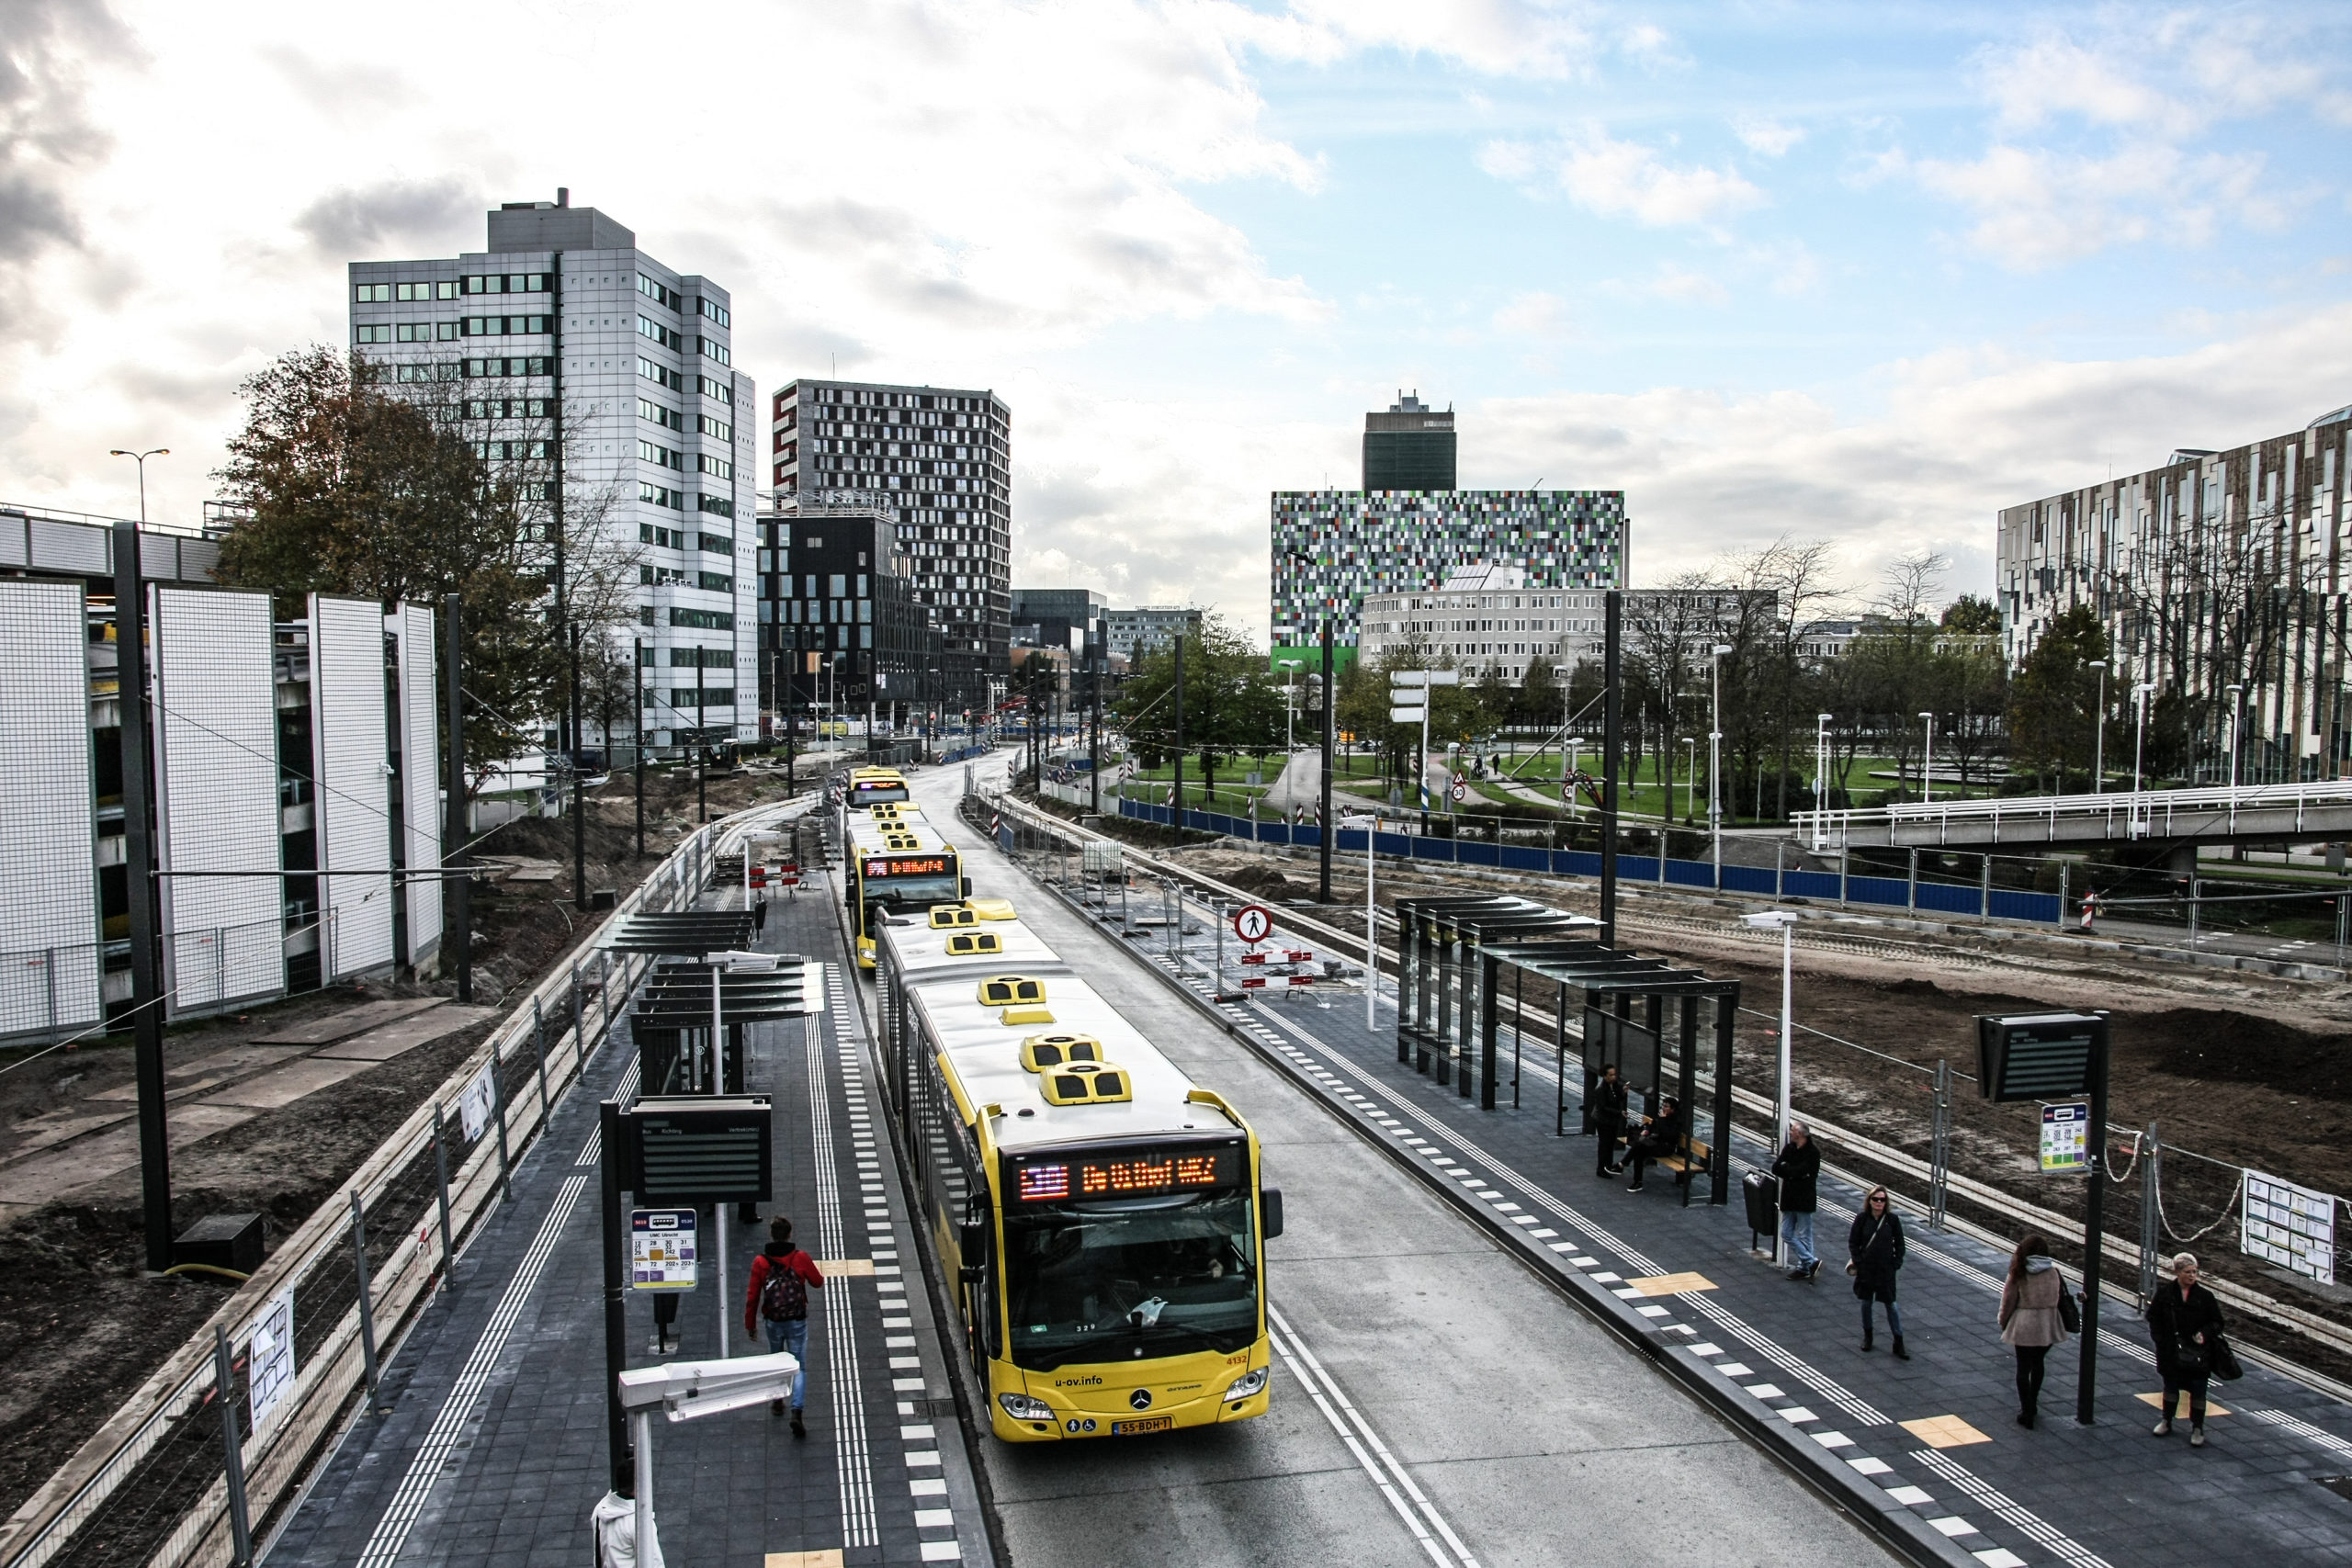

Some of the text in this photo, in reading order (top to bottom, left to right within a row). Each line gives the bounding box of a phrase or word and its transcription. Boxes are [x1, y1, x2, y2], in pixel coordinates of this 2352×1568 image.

[1227, 1355, 1248, 1365] 4132
[1055, 1374, 1102, 1387] u-ov.info
[1122, 1419, 1168, 1433] 55-BDH-1
